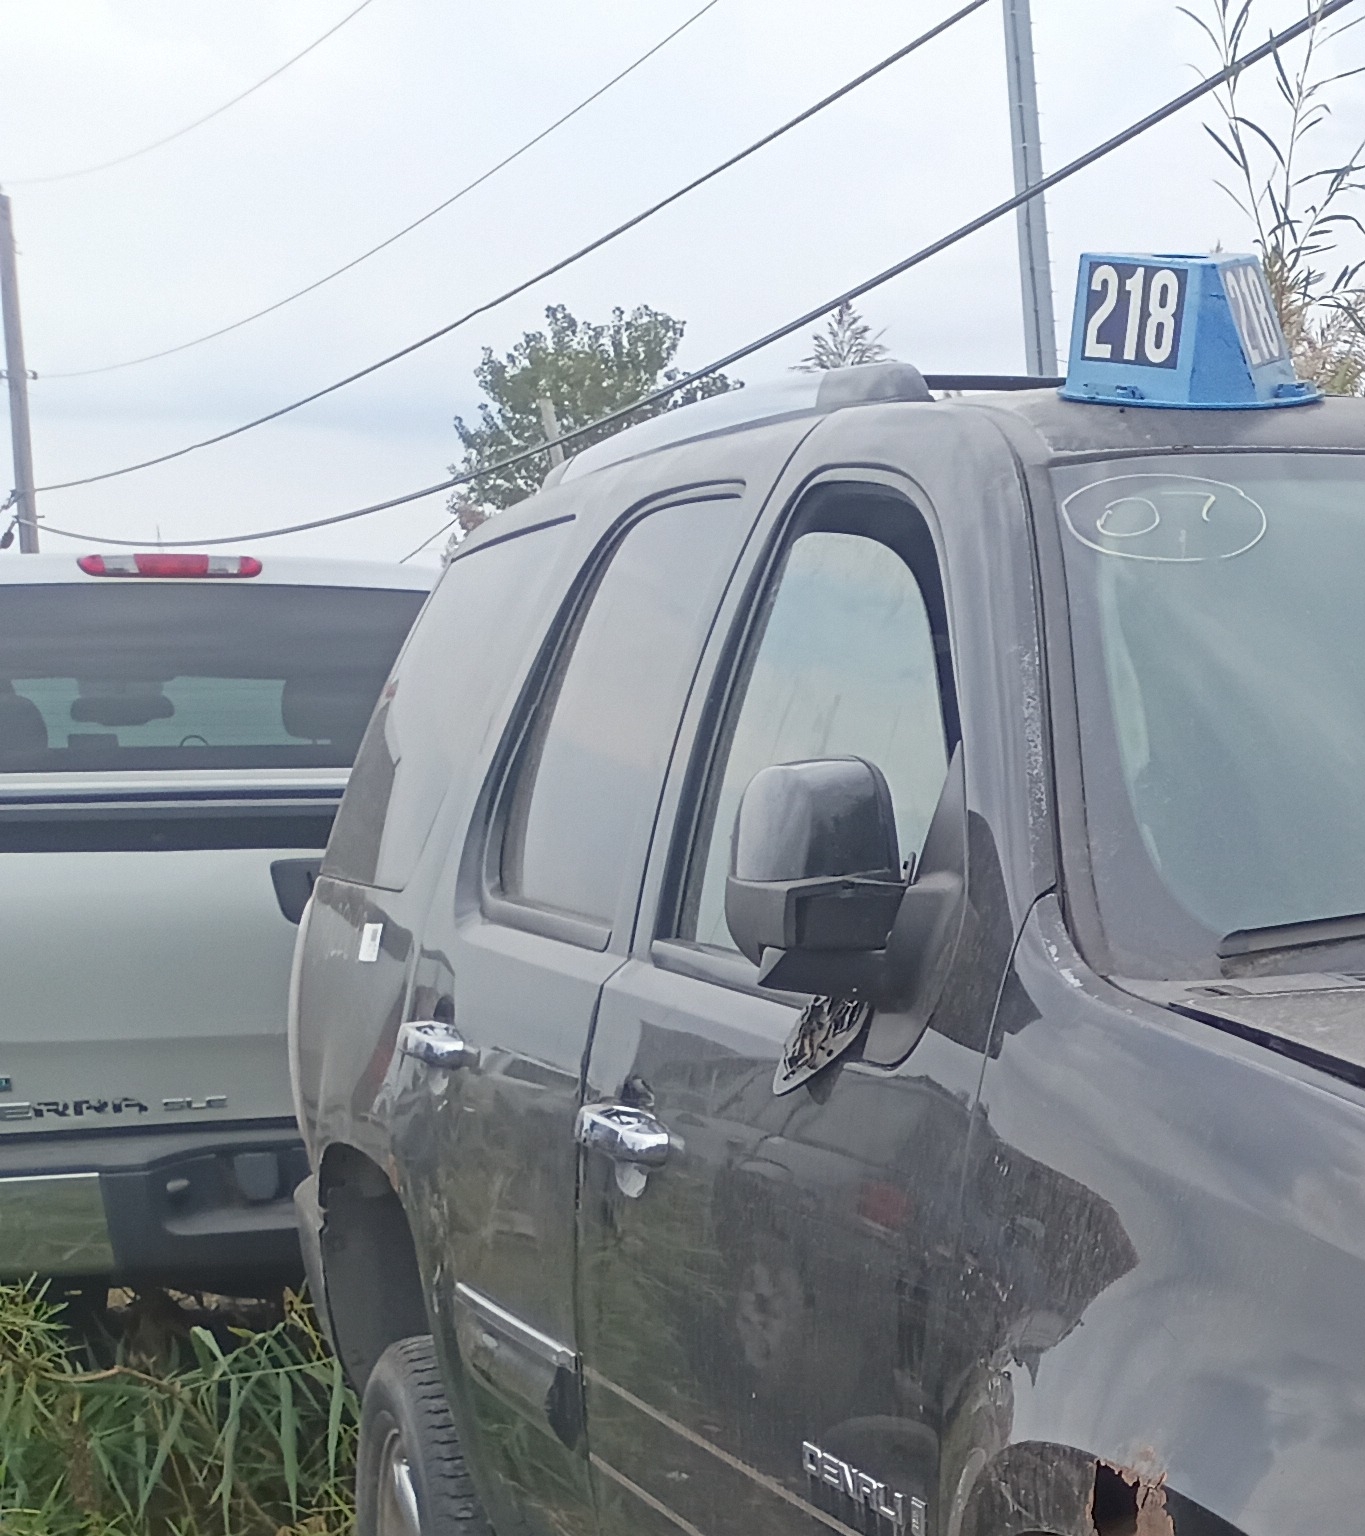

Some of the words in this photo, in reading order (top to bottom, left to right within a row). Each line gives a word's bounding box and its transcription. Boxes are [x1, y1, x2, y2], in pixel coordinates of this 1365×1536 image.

[1085, 265, 1179, 363] 218
[1225, 265, 1279, 364] 218
[803, 1441, 903, 1525] DENALI
